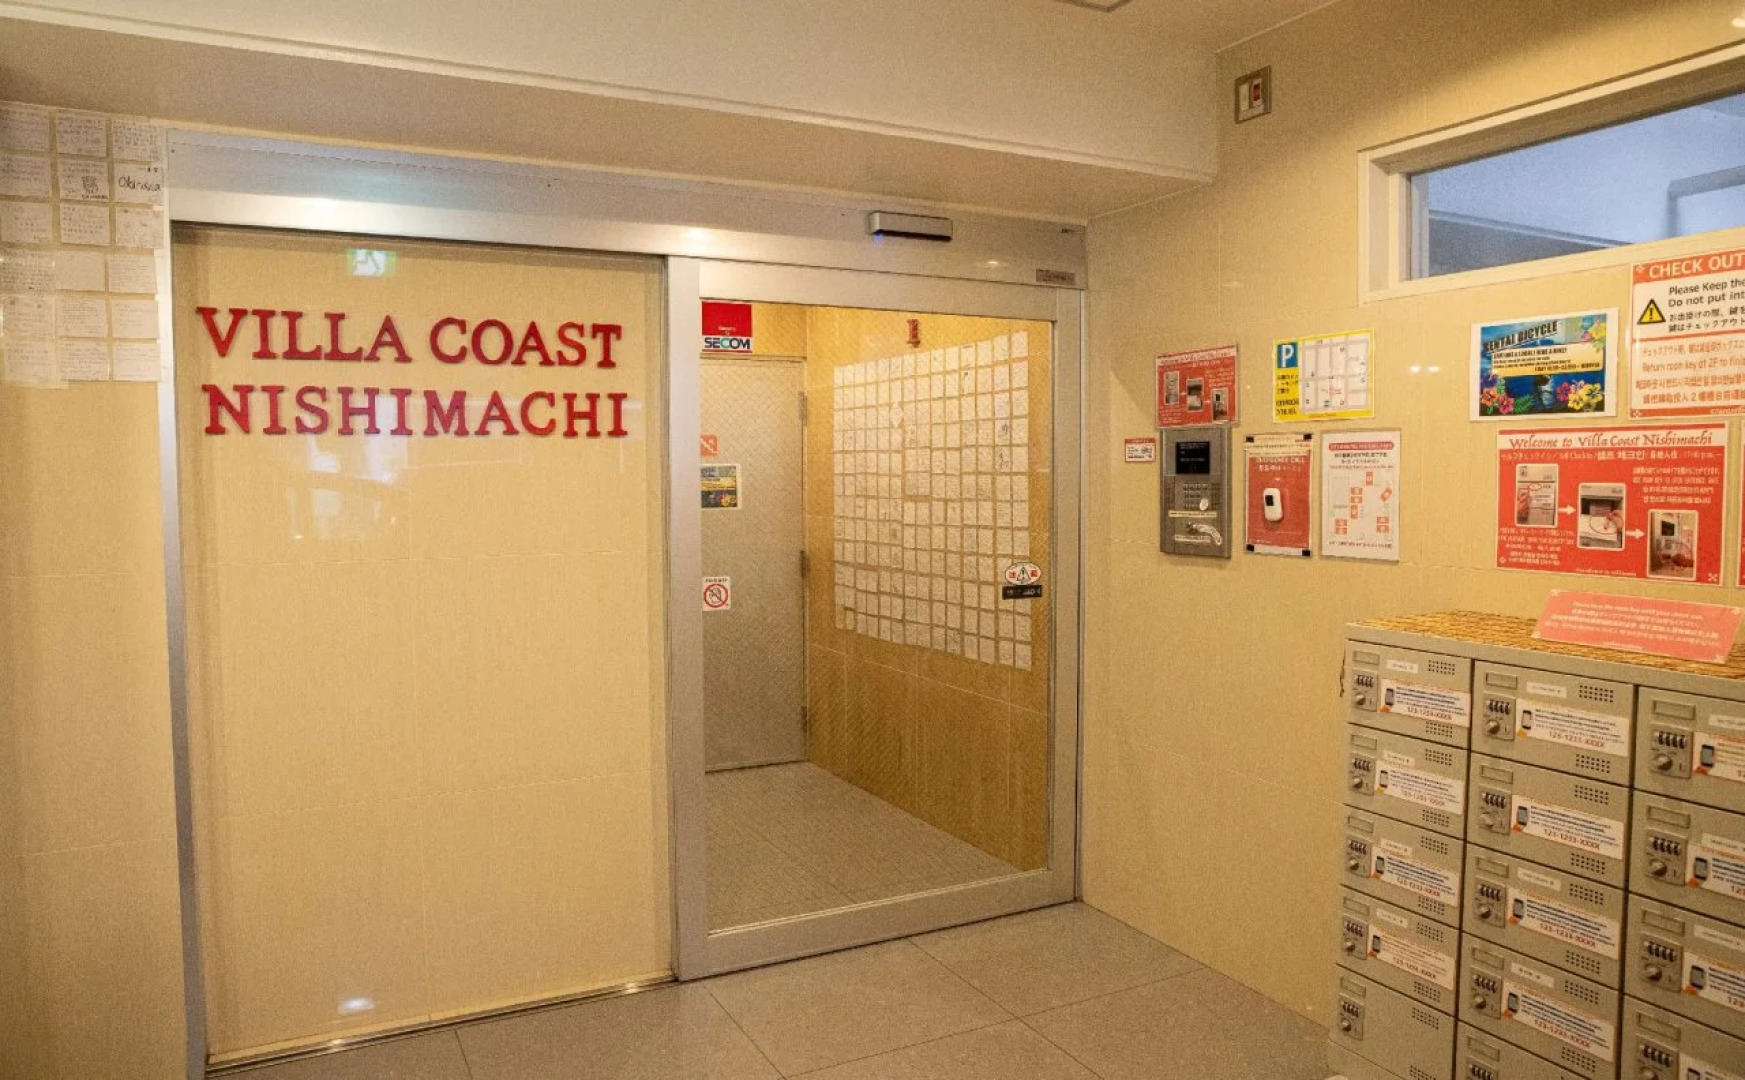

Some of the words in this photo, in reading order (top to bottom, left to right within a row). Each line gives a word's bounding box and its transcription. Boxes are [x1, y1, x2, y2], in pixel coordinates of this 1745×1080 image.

[1649, 259, 1703, 278] CHECK
[1708, 254, 1745, 270] OUT
[1669, 285, 1700, 295] Please
[1702, 282, 1728, 291] Keep
[1668, 298, 1683, 307] Do
[1686, 296, 1704, 305] not
[1707, 293, 1726, 305] put
[195, 307, 412, 363] VILLA
[429, 317, 622, 369] COAST
[1518, 320, 1558, 341] BICYCLE
[704, 337, 750, 350] SECOM
[1281, 344, 1294, 367] P
[202, 384, 628, 437] NISHIMACHI
[1509, 434, 1558, 449] Welcome
[1562, 437, 1573, 447] to
[1578, 433, 1609, 447] Villa
[1610, 434, 1640, 447] Coast
[1643, 431, 1713, 446] Nishimachi
